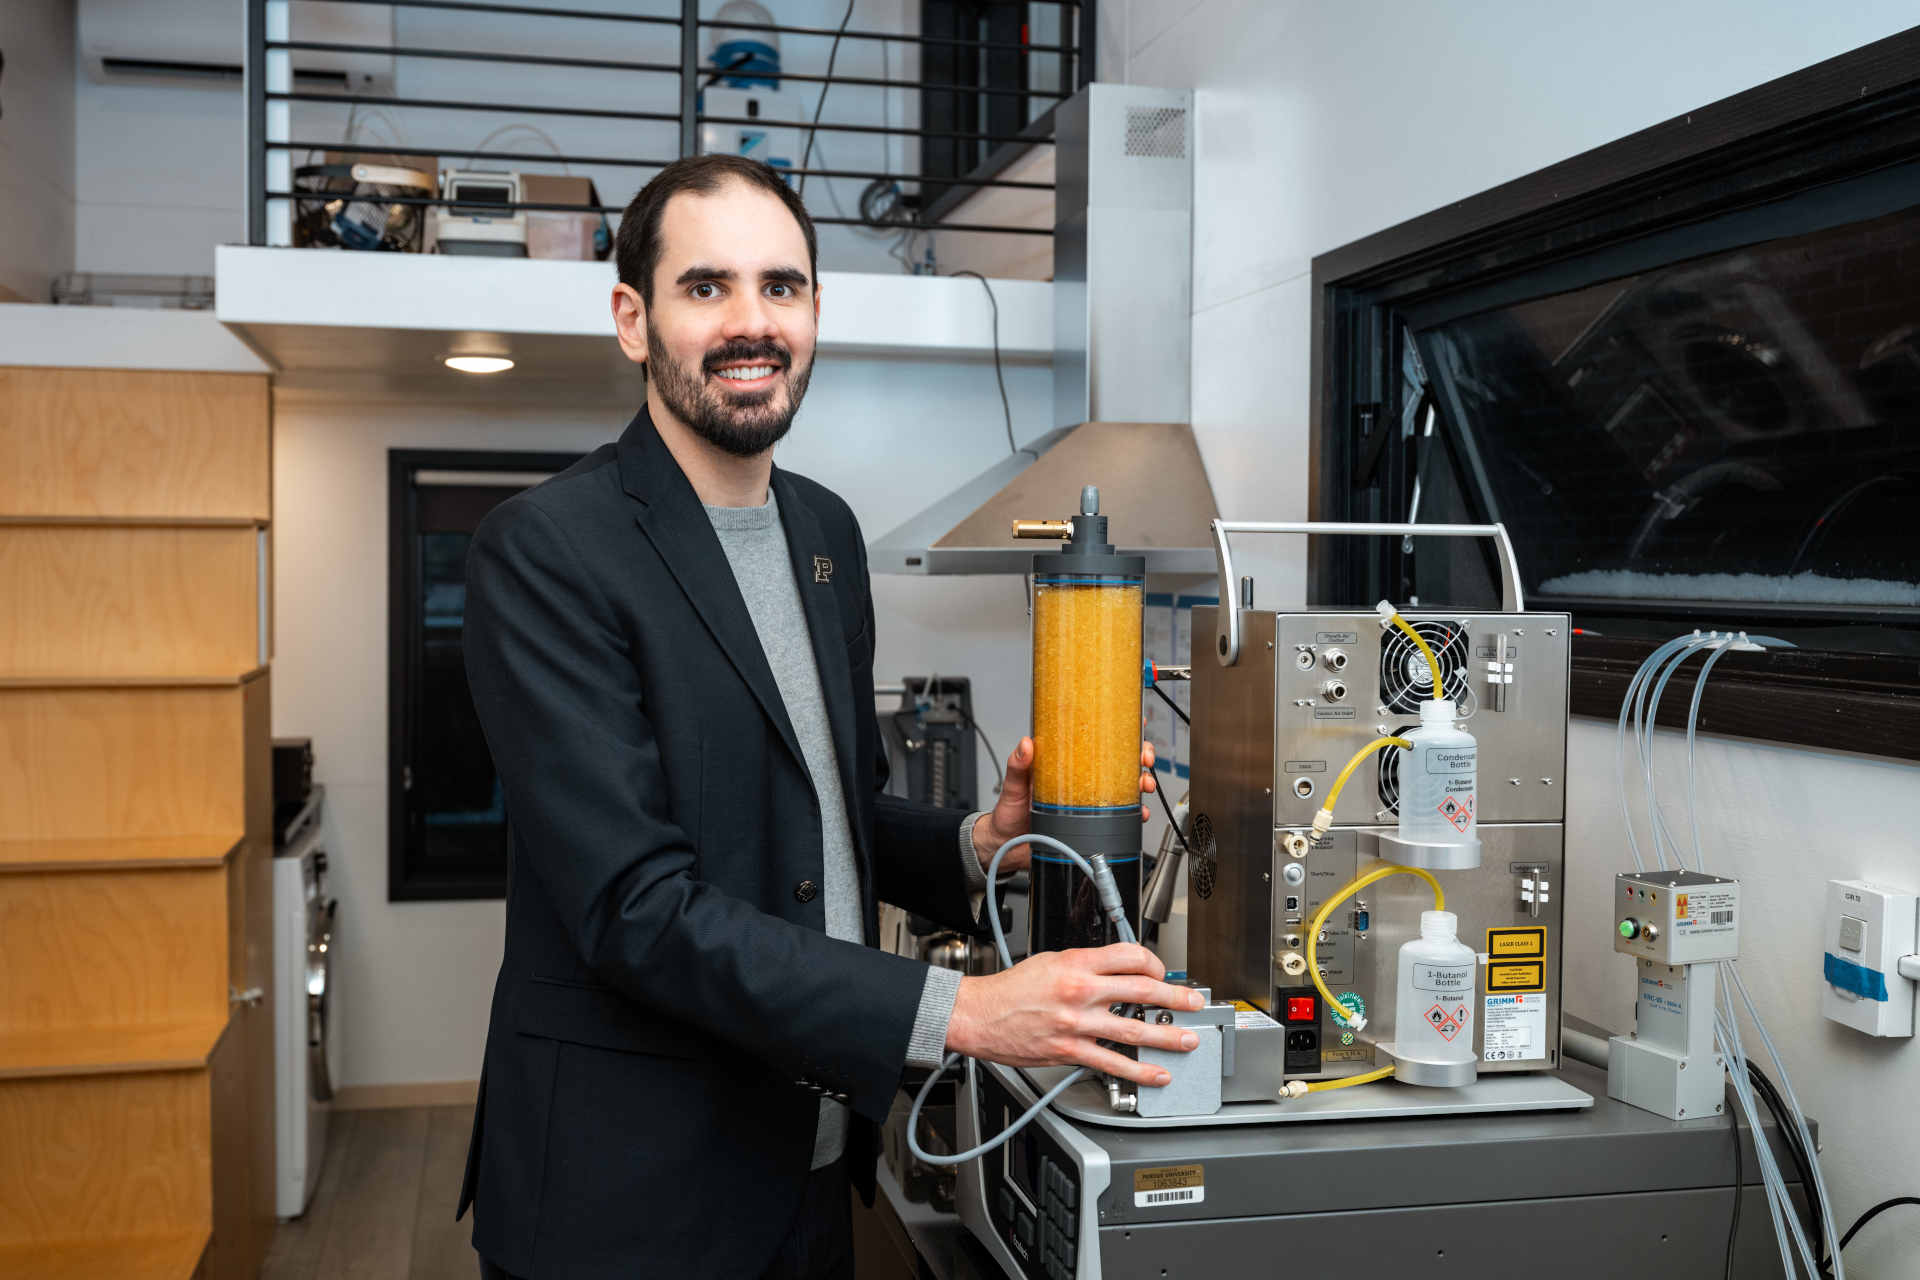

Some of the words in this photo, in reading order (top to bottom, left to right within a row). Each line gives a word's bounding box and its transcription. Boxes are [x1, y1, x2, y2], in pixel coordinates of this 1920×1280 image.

[814, 555, 833, 583] P
[1427, 970, 1467, 979] 1-Butanol
[1487, 997, 1515, 1005] GRIMM
